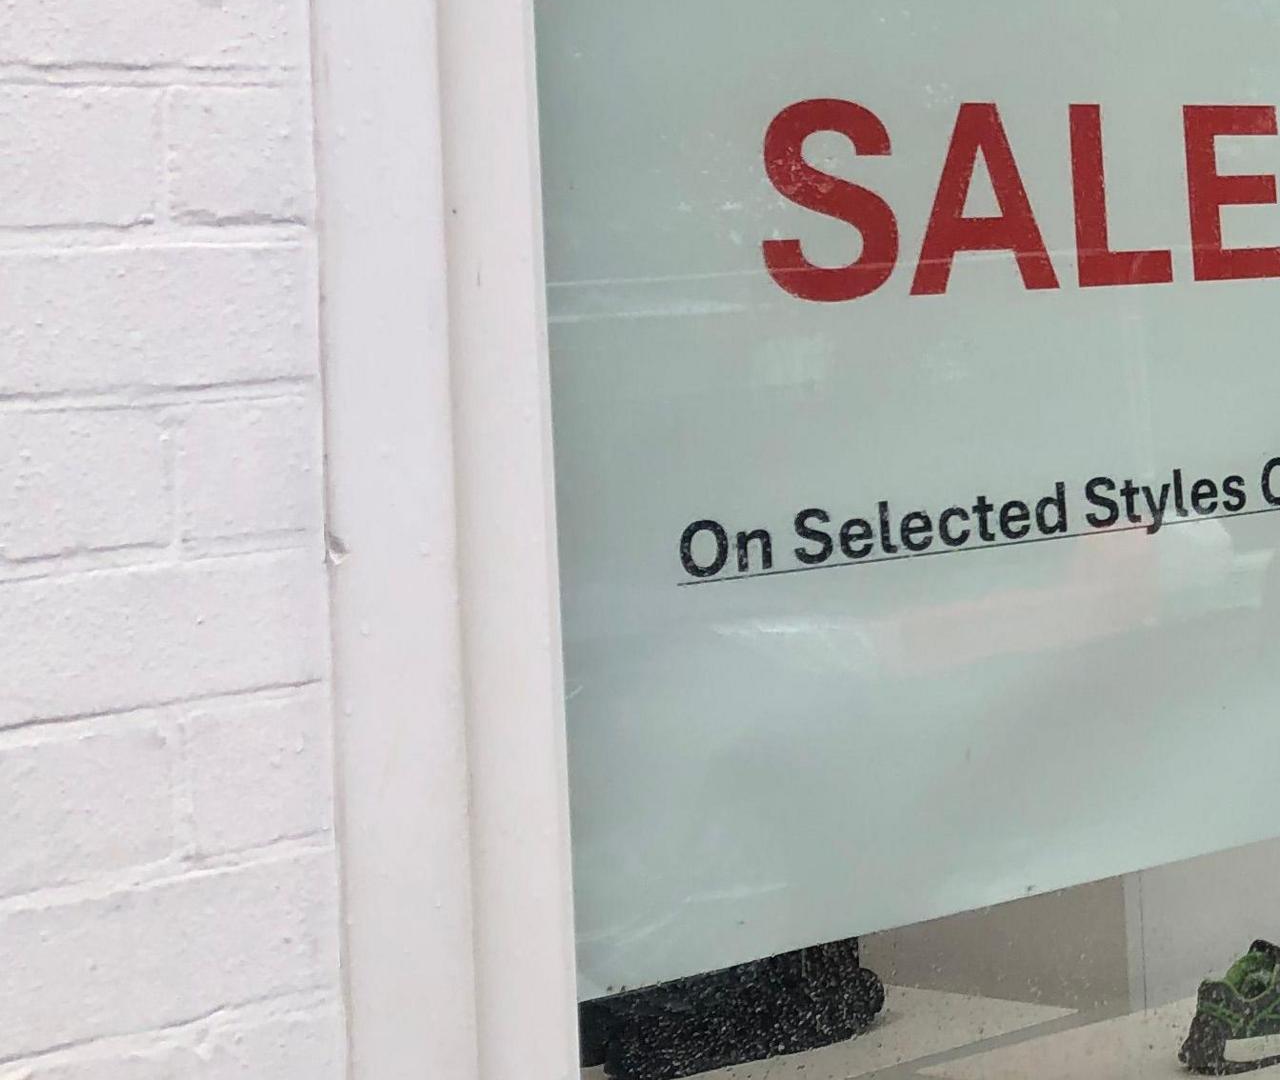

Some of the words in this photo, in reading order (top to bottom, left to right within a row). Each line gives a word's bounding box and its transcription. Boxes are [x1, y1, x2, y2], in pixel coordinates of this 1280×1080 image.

[679, 520, 773, 578] On
[794, 482, 1068, 566] Selected
[1085, 469, 1246, 535] Styles
